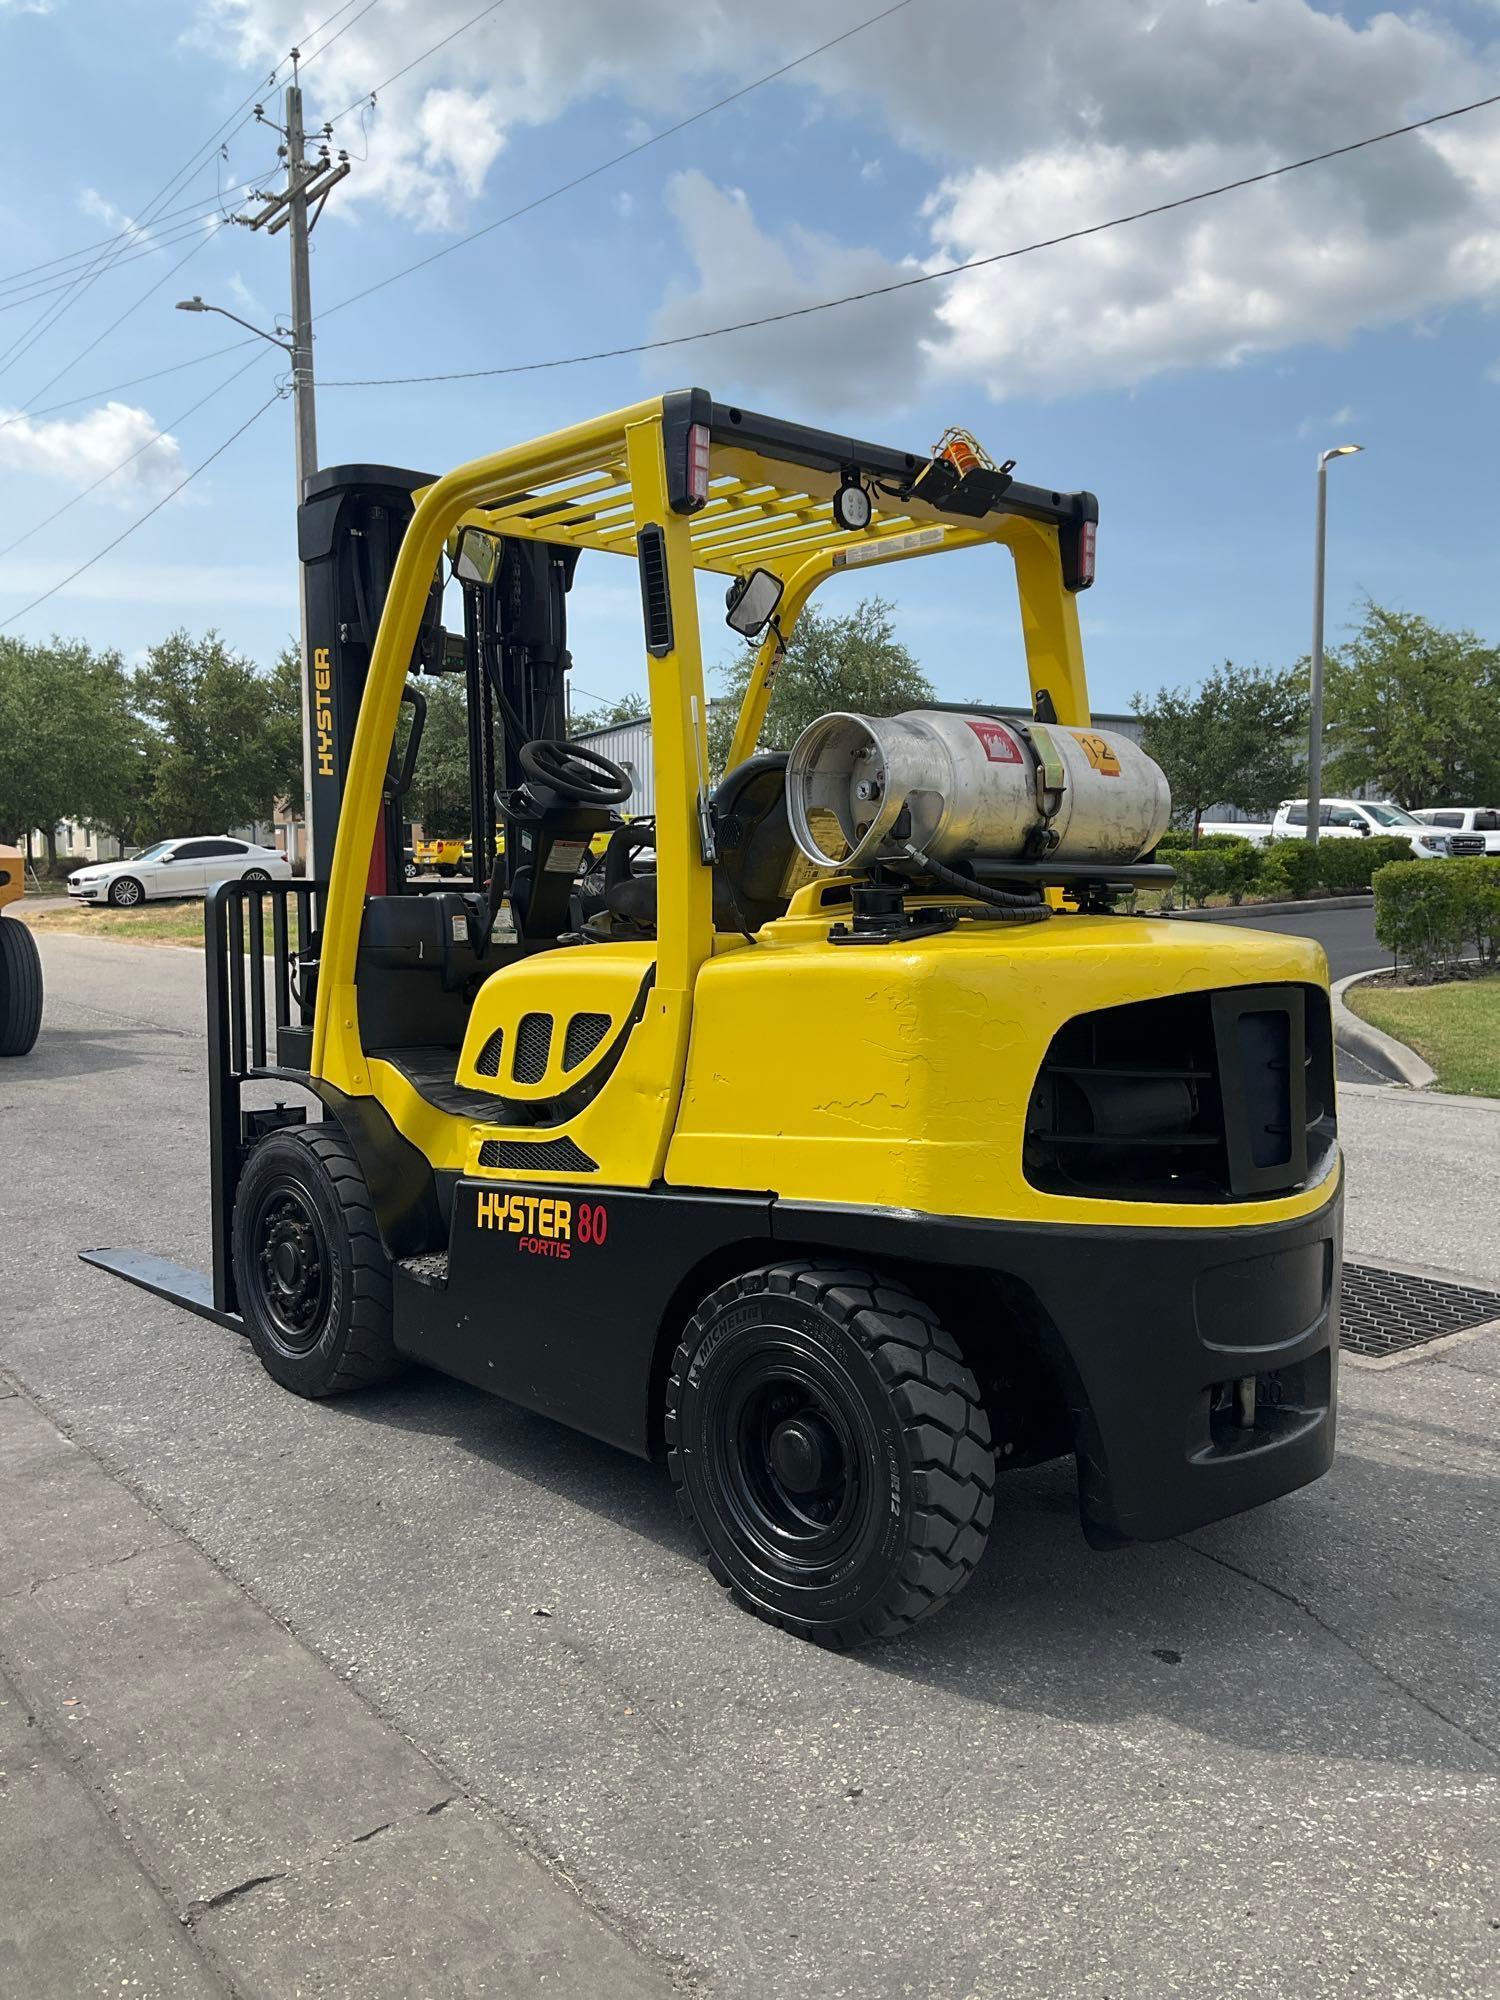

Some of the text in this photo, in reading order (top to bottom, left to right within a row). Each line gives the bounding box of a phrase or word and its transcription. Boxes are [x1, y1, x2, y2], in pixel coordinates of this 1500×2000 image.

[314, 648, 334, 776] HYSTER
[477, 1191, 608, 1246] HYSTER 80
[518, 1236, 572, 1260] FORTIS
[699, 1306, 760, 1363] MICHELIN
